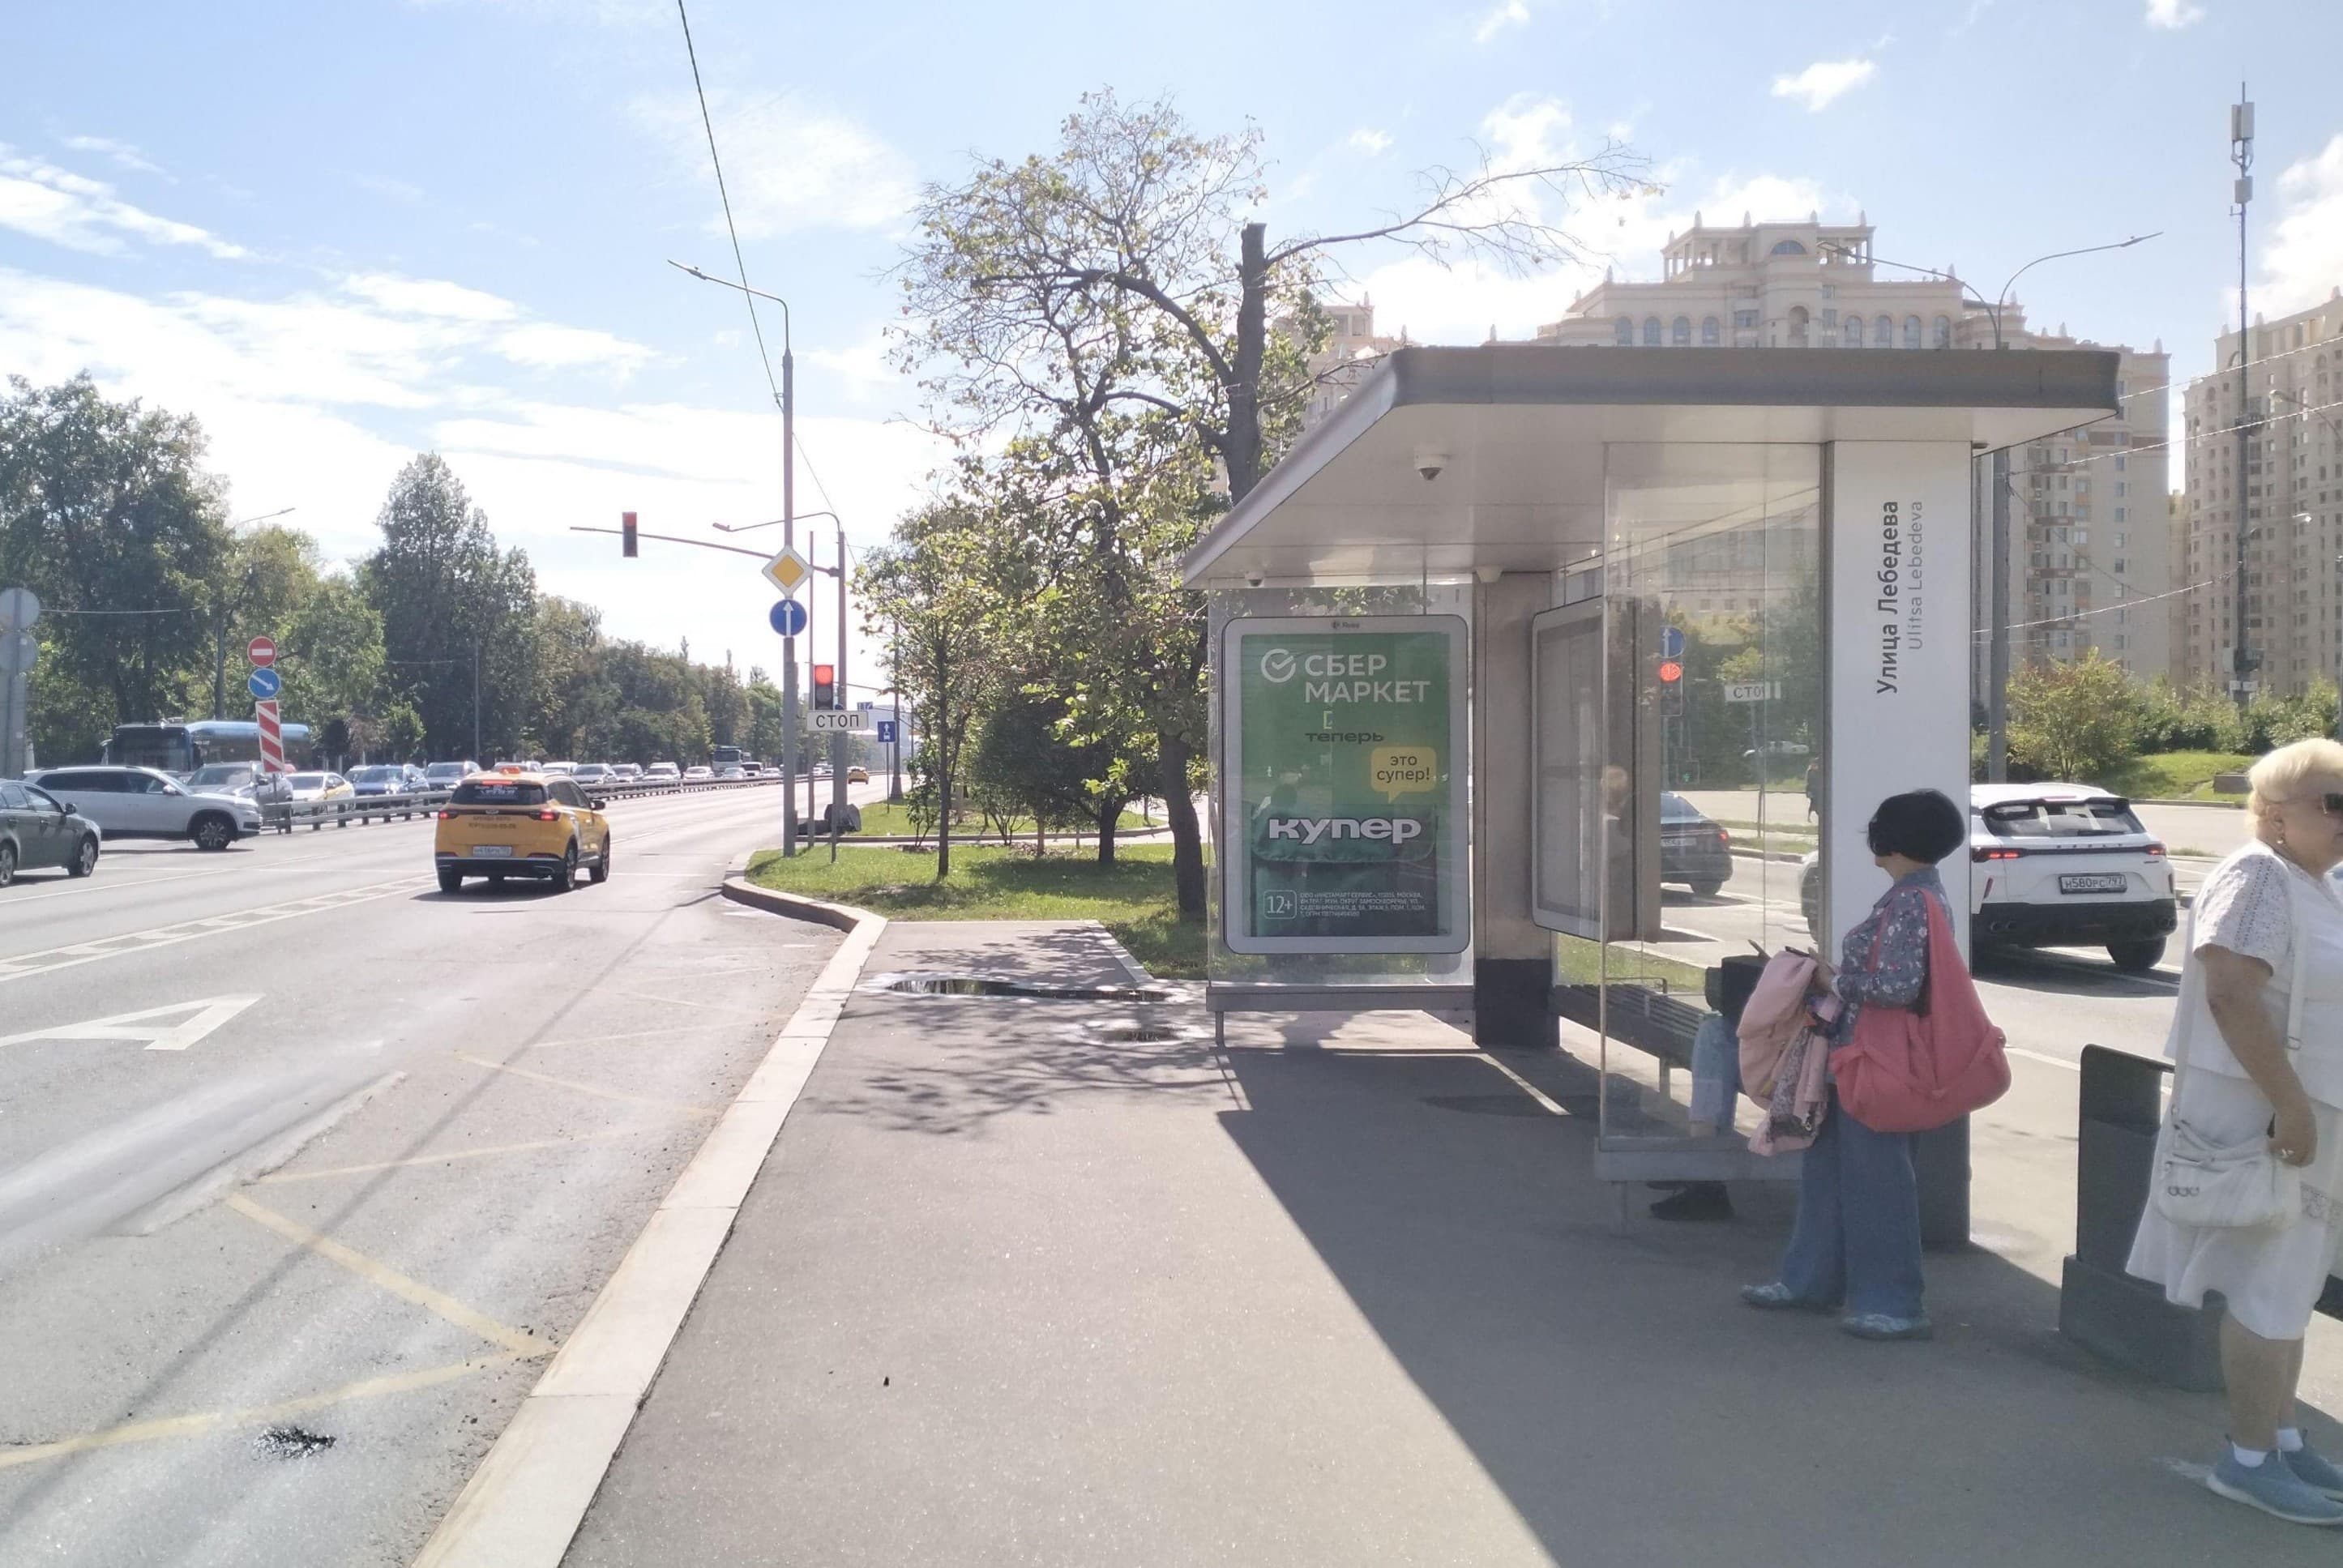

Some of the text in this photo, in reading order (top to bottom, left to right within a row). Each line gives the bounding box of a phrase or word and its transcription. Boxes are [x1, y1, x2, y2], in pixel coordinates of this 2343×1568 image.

[1907, 501, 1923, 649] Ulitsa Lebedeva
[1876, 501, 1901, 694] Улица Лебедева
[1305, 655, 1387, 676] СБЕР
[1305, 681, 1431, 703] МАРКЕТ
[815, 715, 859, 728] СТОП
[1305, 733, 1384, 744] теперь
[1390, 756, 1417, 766] это
[1377, 767, 1430, 784] супер!
[1269, 818, 1422, 844] купер
[1267, 895, 1293, 913] 12+
